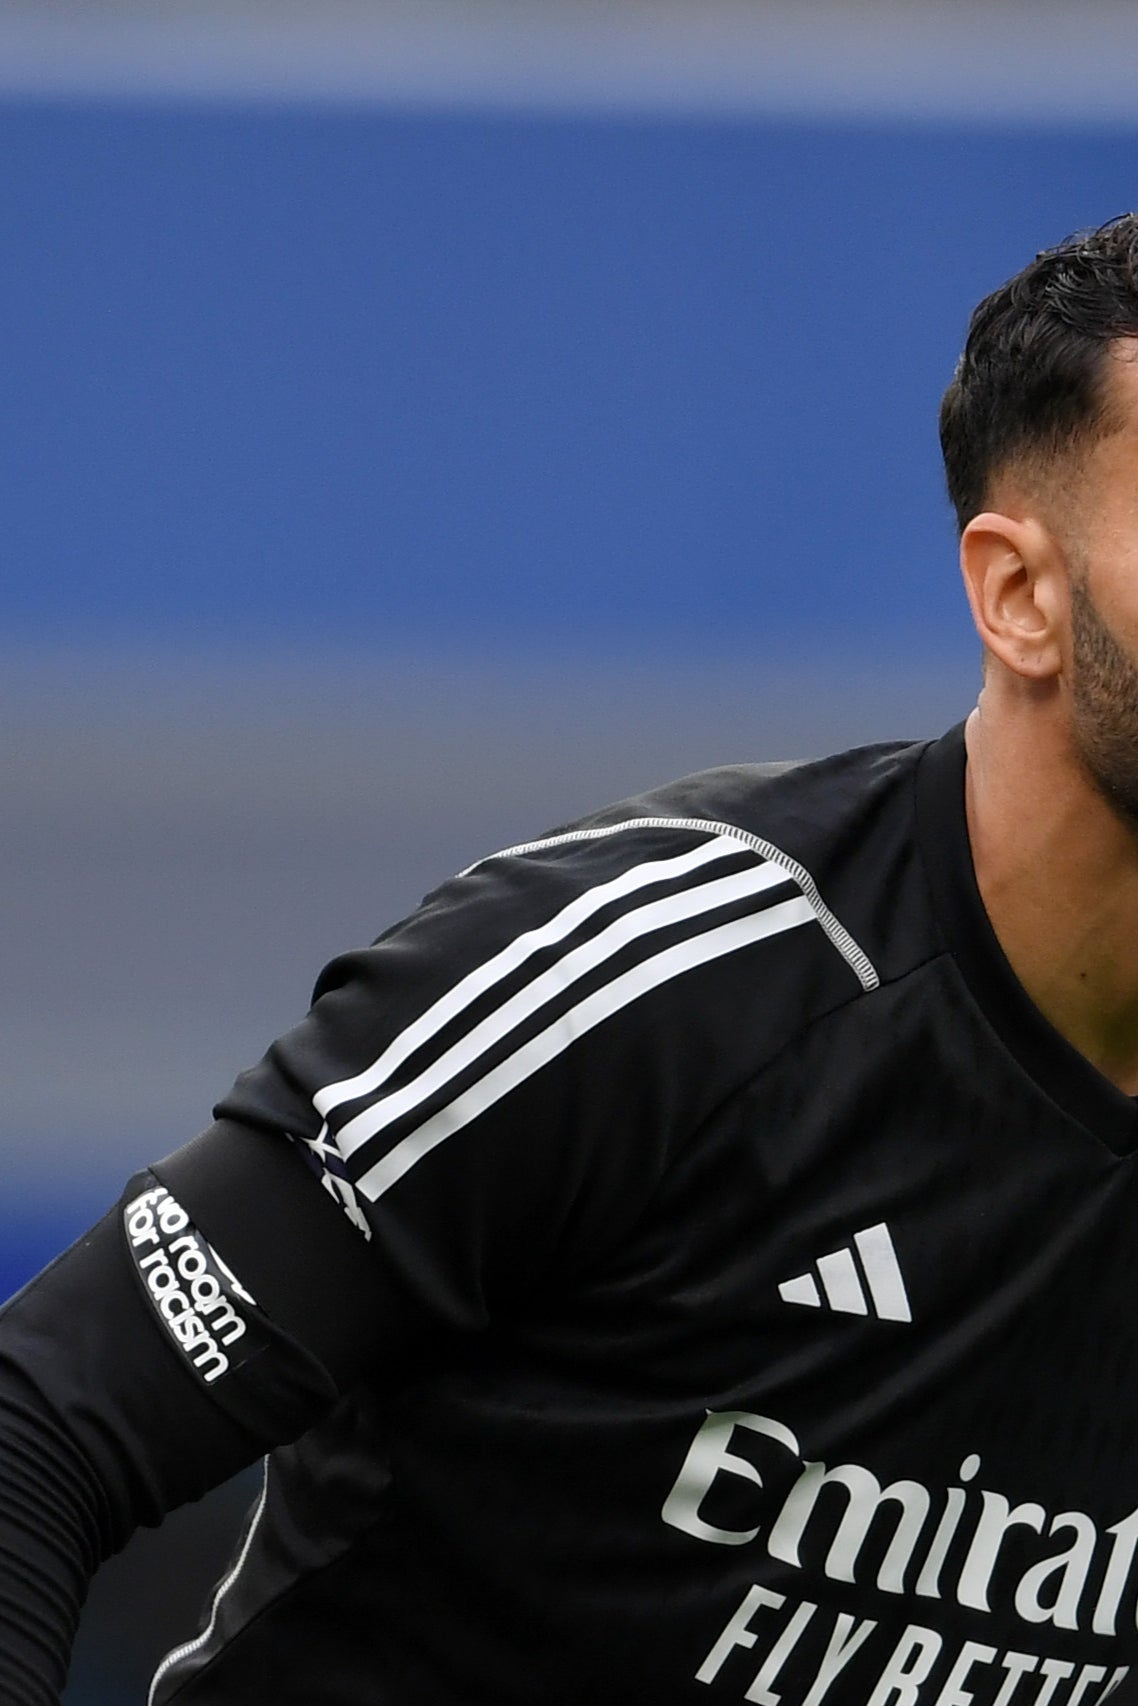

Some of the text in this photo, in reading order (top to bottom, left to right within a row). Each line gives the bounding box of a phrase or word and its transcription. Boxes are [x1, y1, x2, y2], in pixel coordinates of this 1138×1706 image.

[125, 1191, 229, 1382] for racism
[168, 1235, 246, 1346] room
[694, 1583, 878, 1706] FLY
